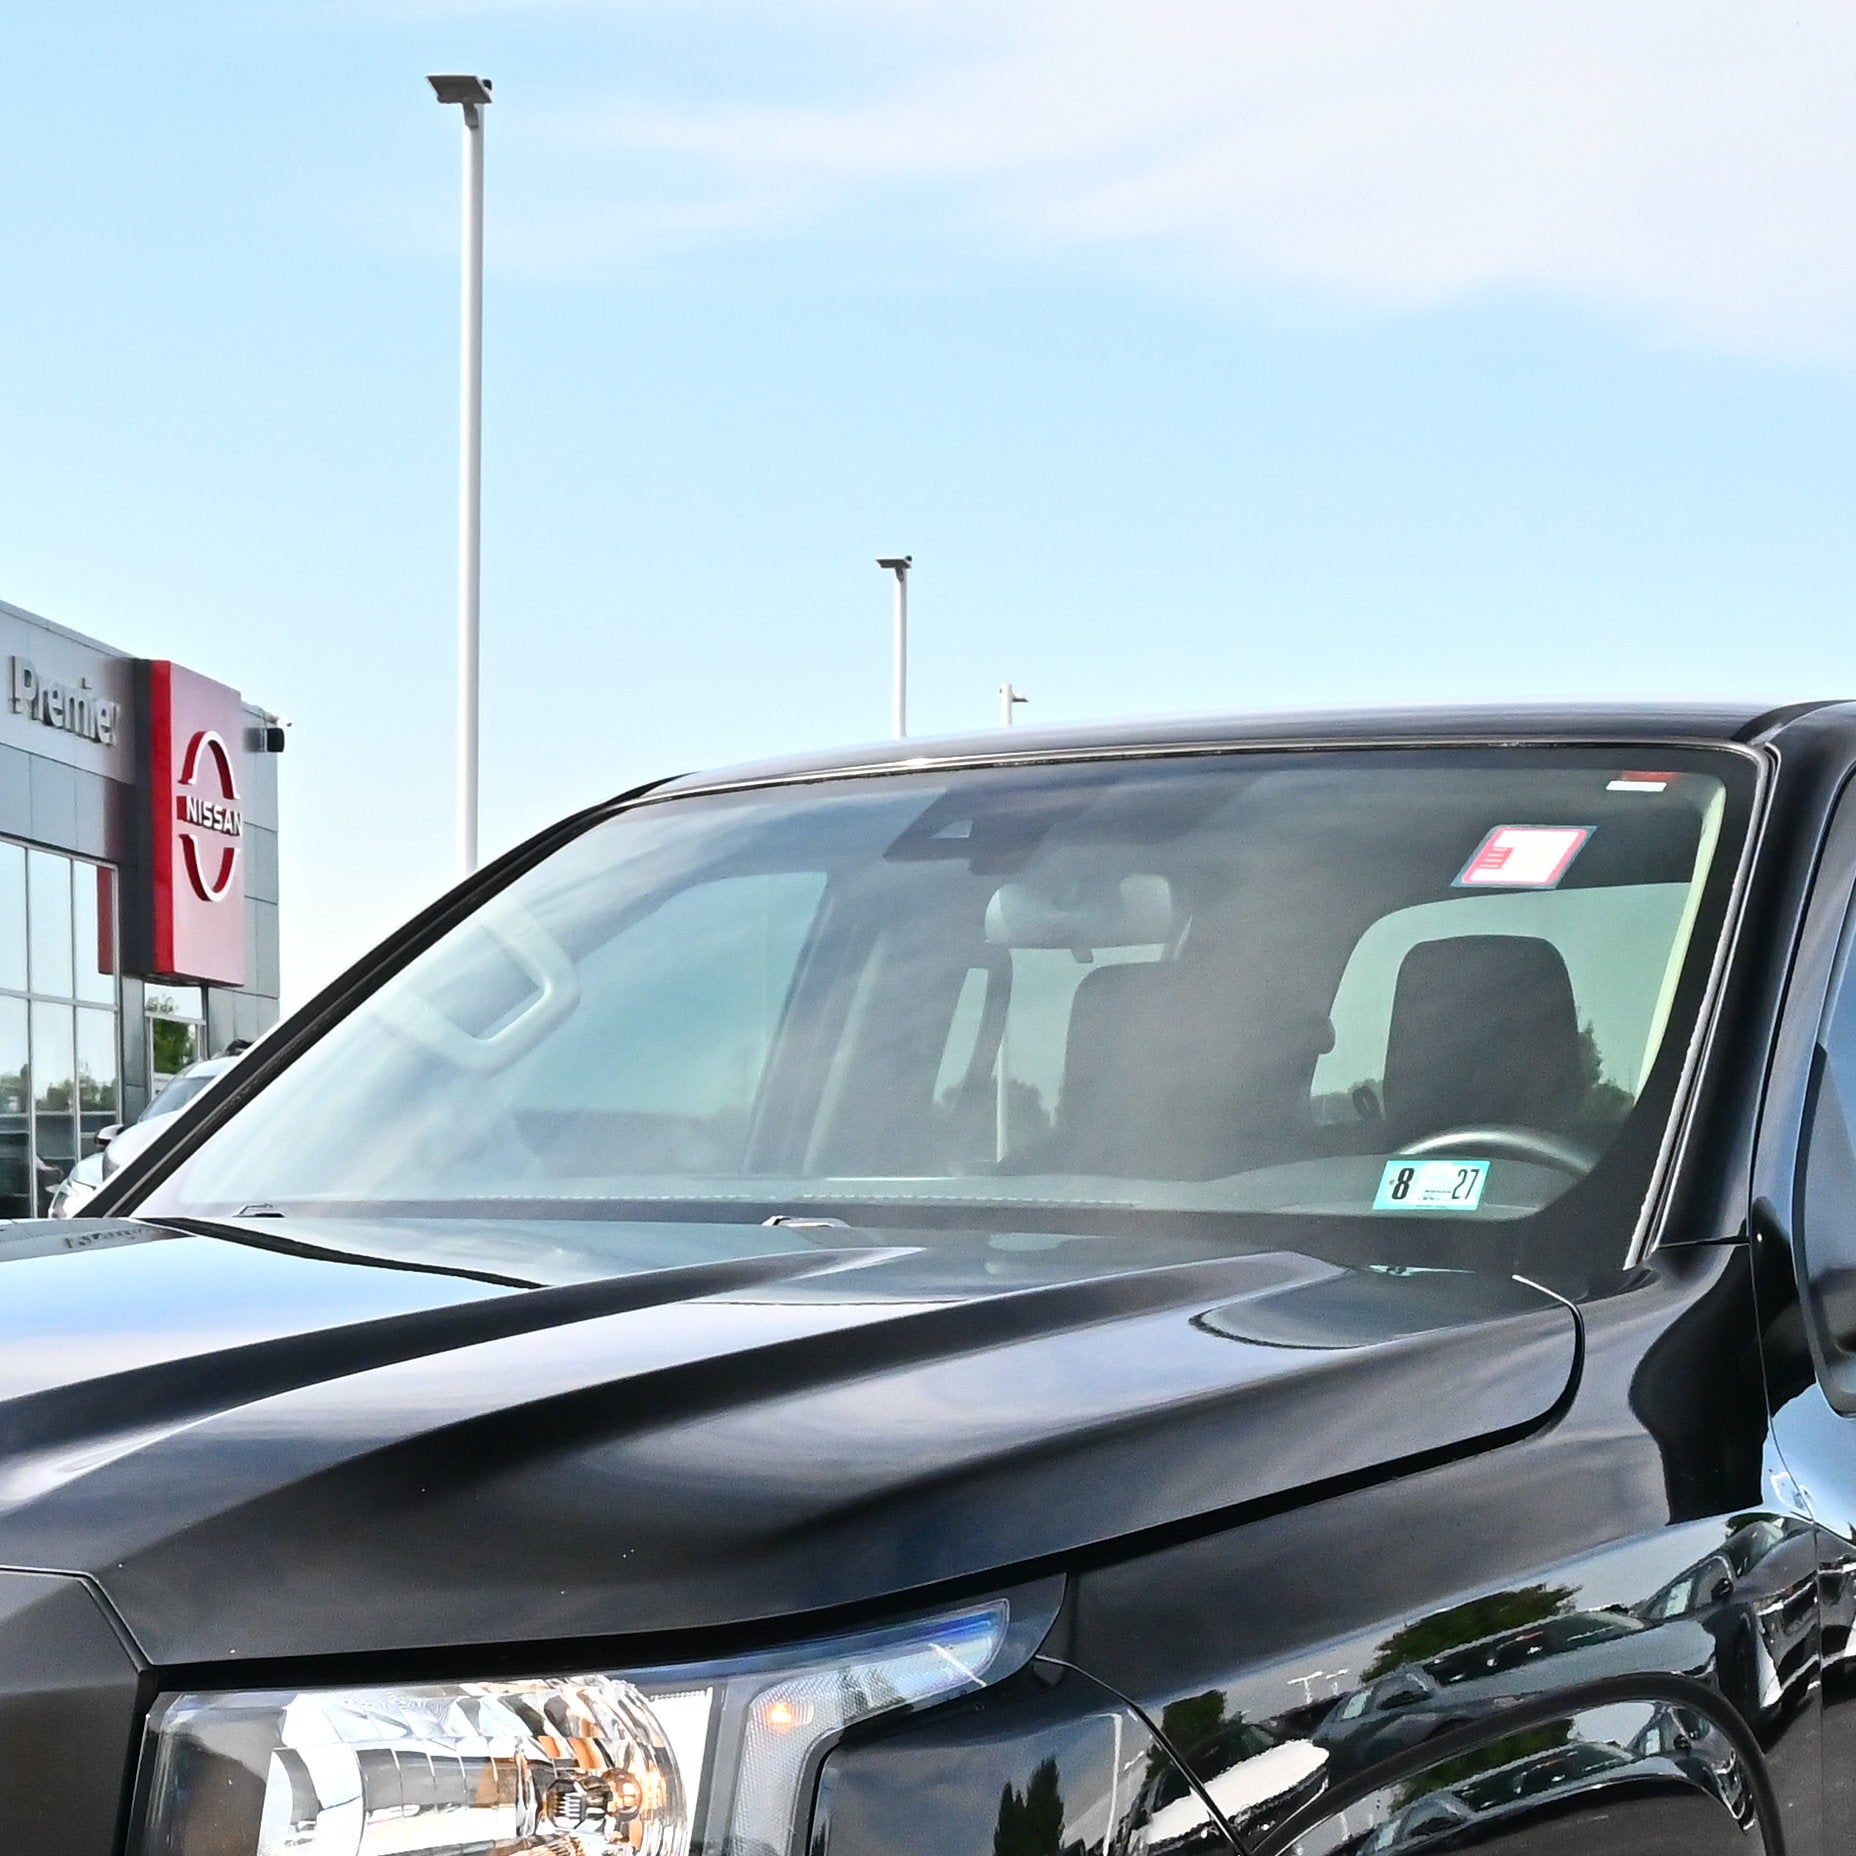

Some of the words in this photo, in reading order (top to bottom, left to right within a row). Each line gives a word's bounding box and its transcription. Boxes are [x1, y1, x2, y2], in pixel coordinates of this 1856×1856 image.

[185, 795, 243, 836] NISSAN
[1391, 1167, 1415, 1200] 8
[1451, 1168, 1480, 1200] 27
